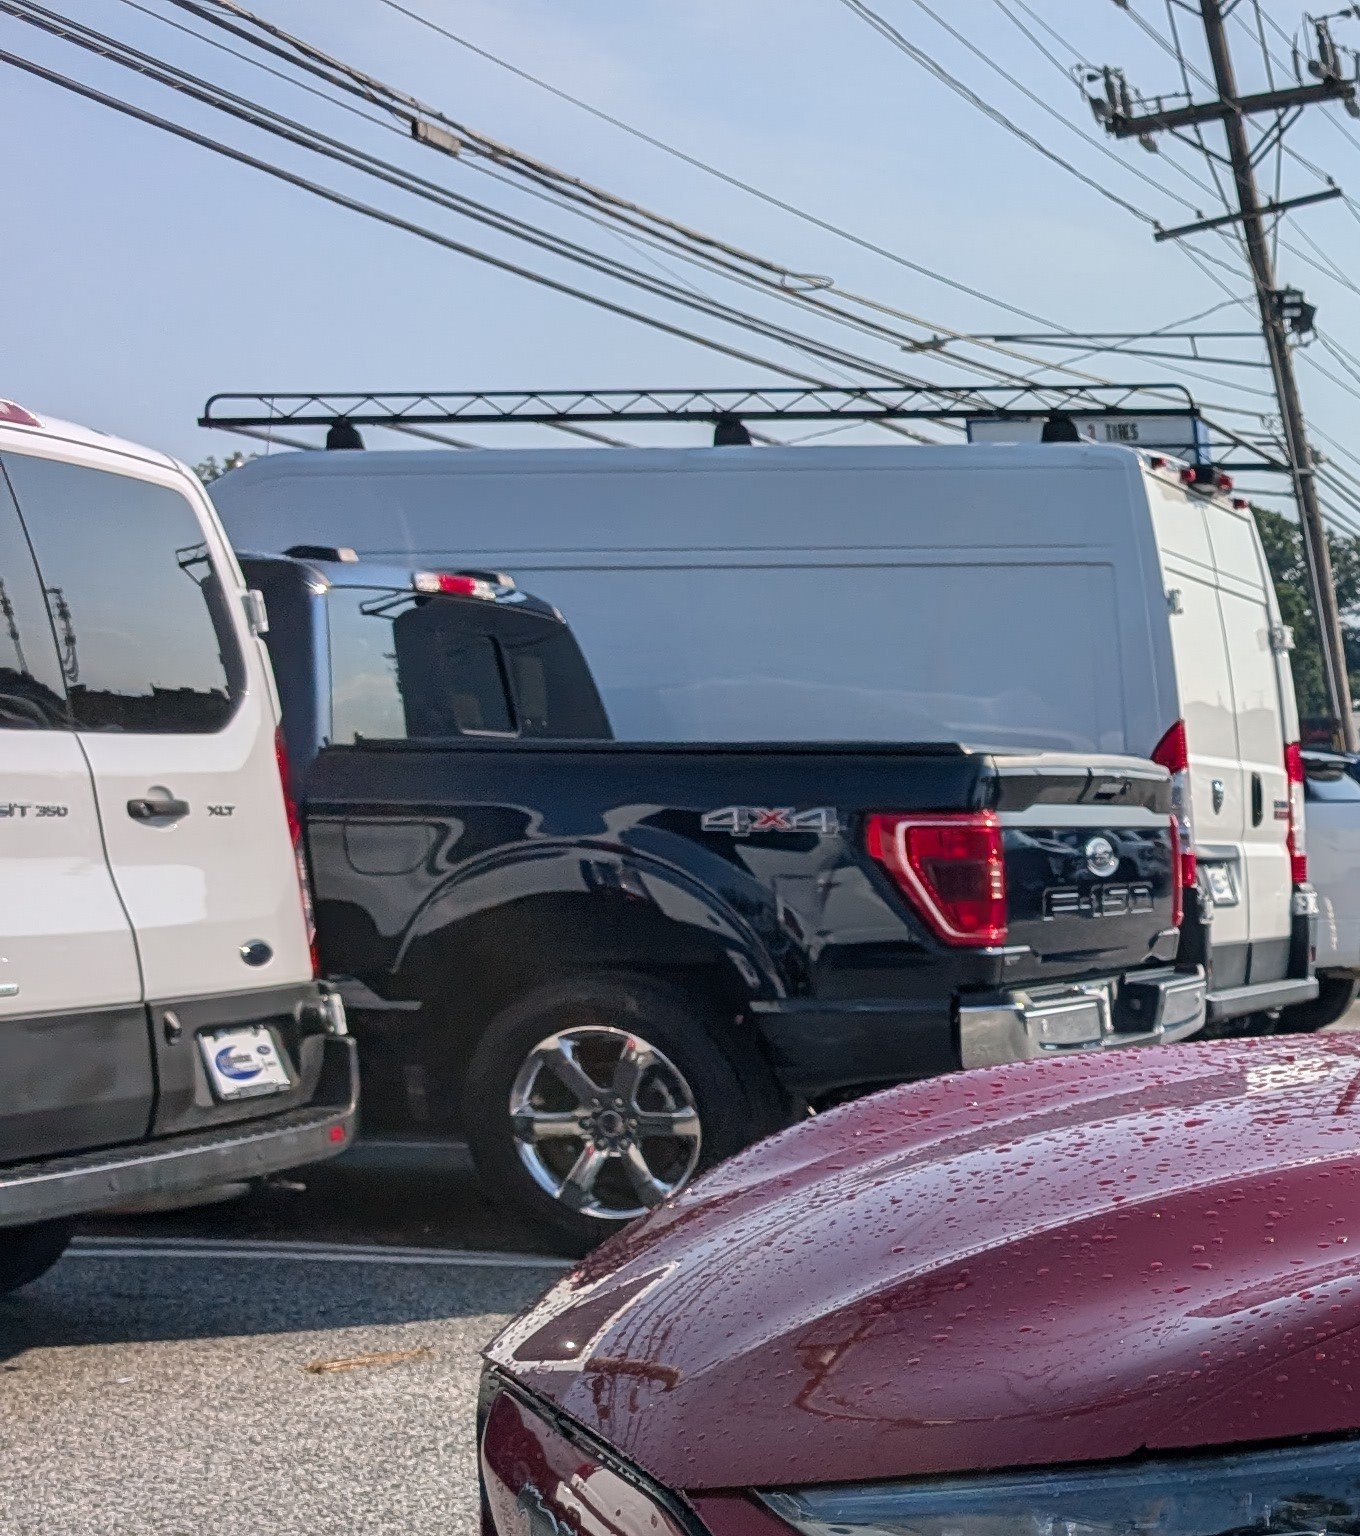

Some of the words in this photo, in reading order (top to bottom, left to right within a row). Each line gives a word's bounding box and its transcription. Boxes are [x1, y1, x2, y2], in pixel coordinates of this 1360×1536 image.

[35, 805, 68, 817] 350
[207, 805, 236, 816] XLT
[1042, 881, 1153, 920] F-150
